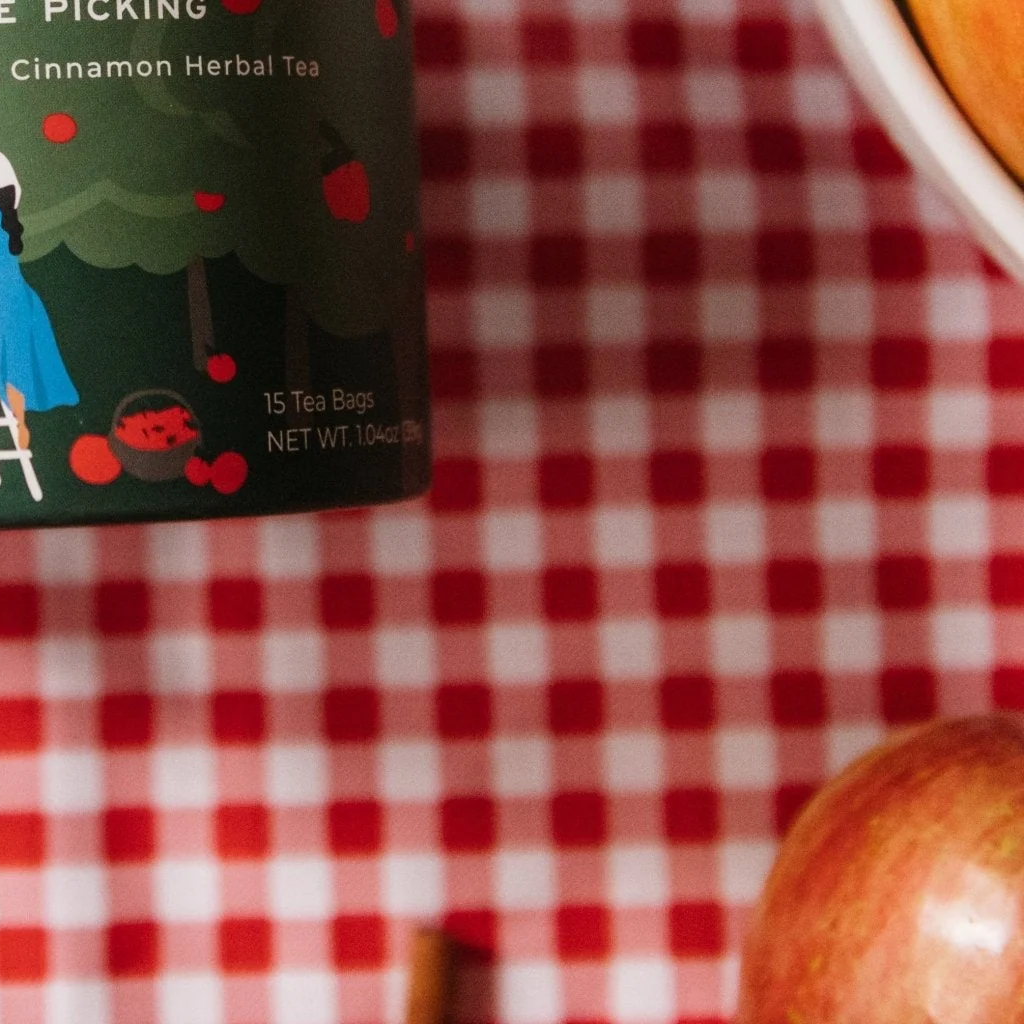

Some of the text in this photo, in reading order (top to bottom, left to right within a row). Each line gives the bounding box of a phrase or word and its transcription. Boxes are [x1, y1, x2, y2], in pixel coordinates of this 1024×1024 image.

[10, 56, 173, 82] Cinnamon
[184, 54, 275, 78] Herbal
[284, 55, 321, 78] Tea
[264, 388, 375, 414] 15 Tea Bags
[267, 427, 311, 453] NET
[317, 425, 352, 449] WT.
[356, 423, 399, 446] 1.04oz
